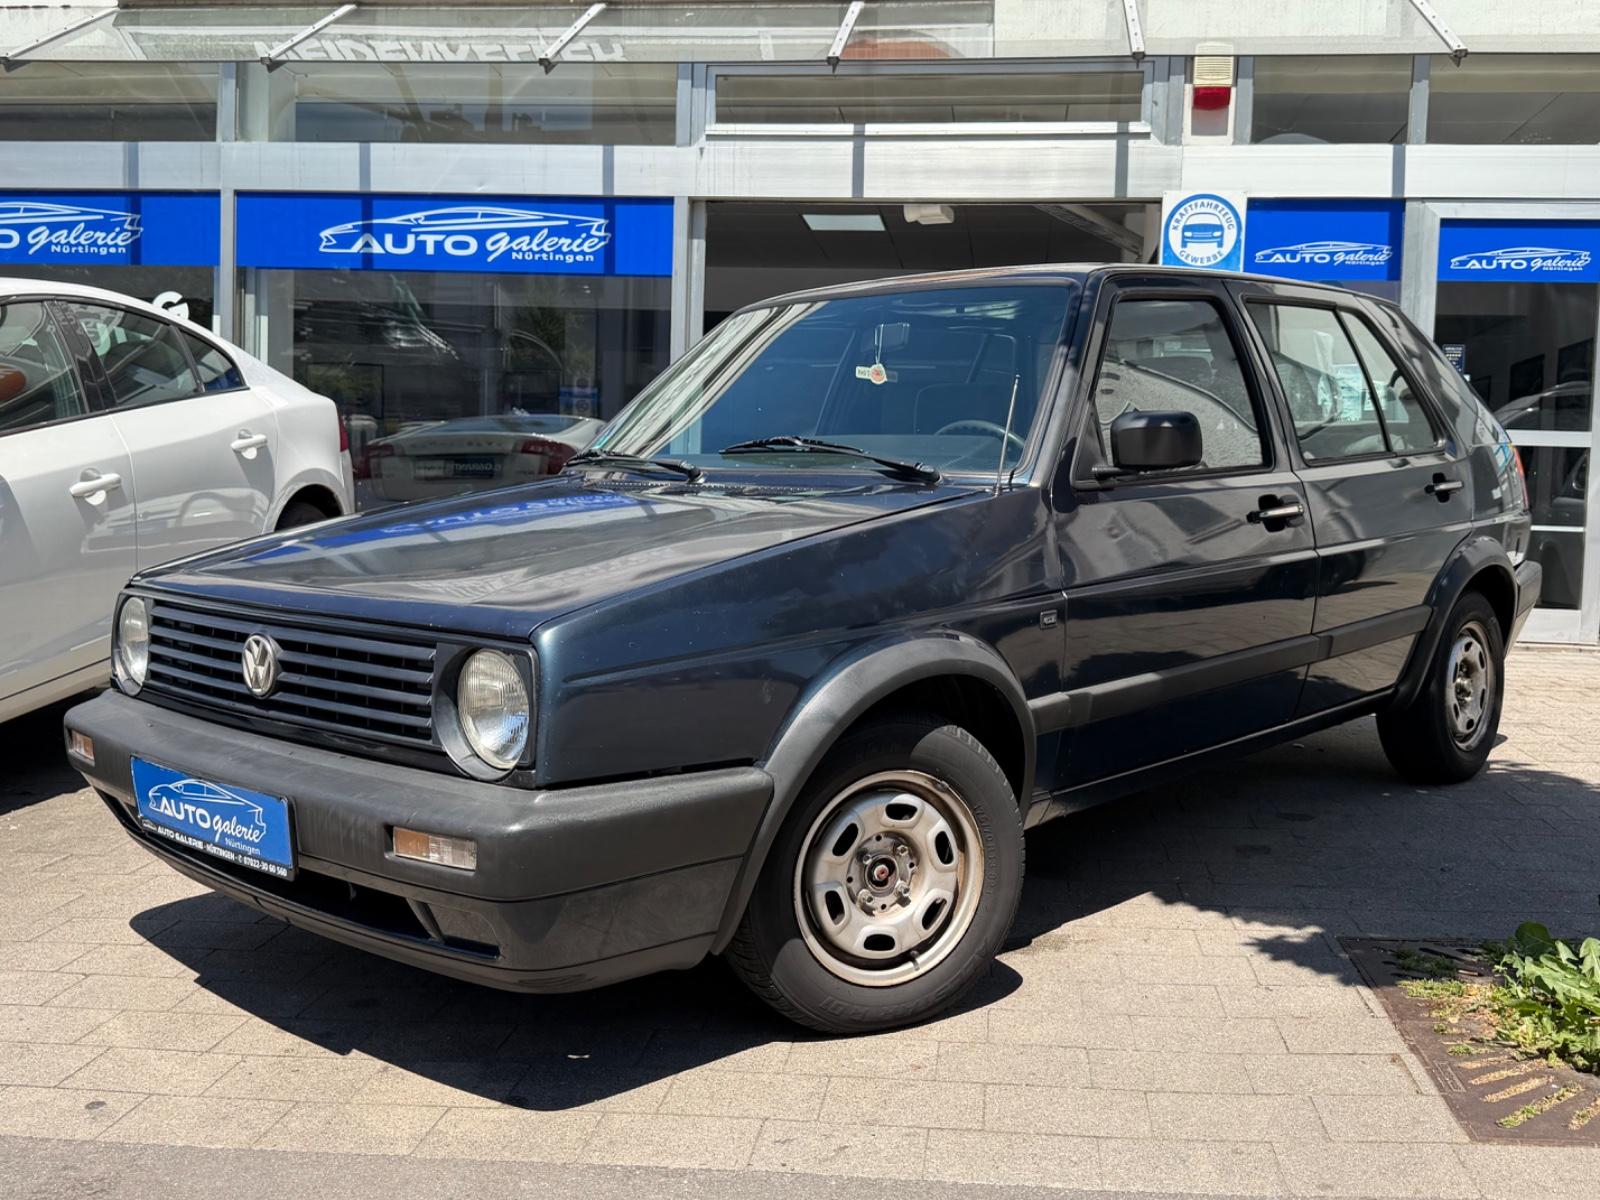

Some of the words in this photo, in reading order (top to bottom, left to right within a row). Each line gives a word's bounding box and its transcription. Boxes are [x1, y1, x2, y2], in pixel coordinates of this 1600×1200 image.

[1171, 200, 1235, 231] KRAFTFAHRZEUG
[27, 222, 134, 255] galerie
[353, 233, 478, 256] AUTO
[485, 228, 602, 262] galerie
[51, 244, 126, 255] Nürtingen
[511, 251, 595, 263] Nürtingen
[1180, 250, 1224, 263] GEWERBE
[1270, 253, 1331, 263] AUTO
[1333, 250, 1388, 266] galerie
[1465, 259, 1527, 269] AUTO
[1530, 256, 1587, 272] galerie
[160, 796, 211, 828] AUTO
[212, 815, 264, 843] galerie
[157, 825, 175, 839] AUTO
